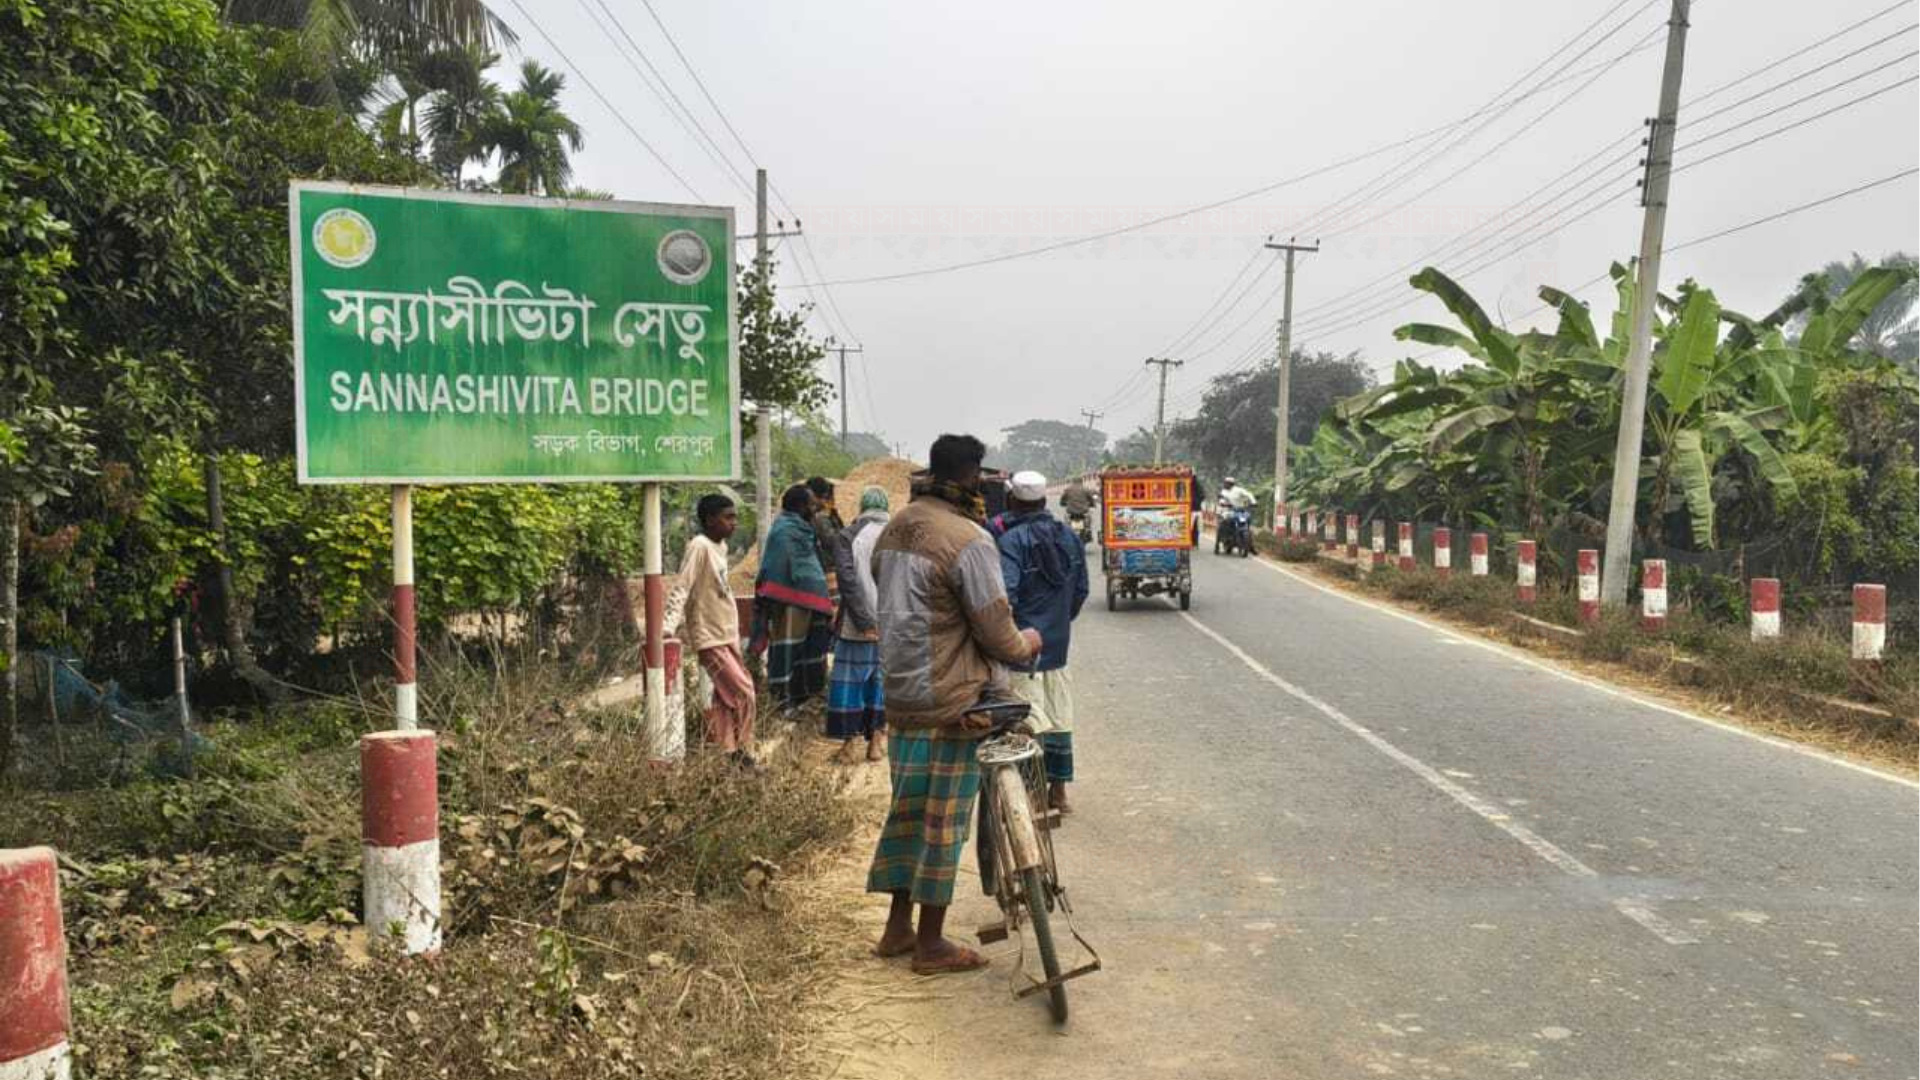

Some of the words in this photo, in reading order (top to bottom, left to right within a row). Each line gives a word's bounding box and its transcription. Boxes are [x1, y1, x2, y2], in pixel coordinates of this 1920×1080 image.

[321, 275, 599, 353] সন্ন্যাসীভিটা
[613, 301, 711, 364] সেতু
[329, 371, 583, 415] SANNASHIVITA
[590, 378, 709, 417] BRIDGE
[532, 434, 579, 457] সড়ক
[655, 434, 715, 457] শেরপুর
